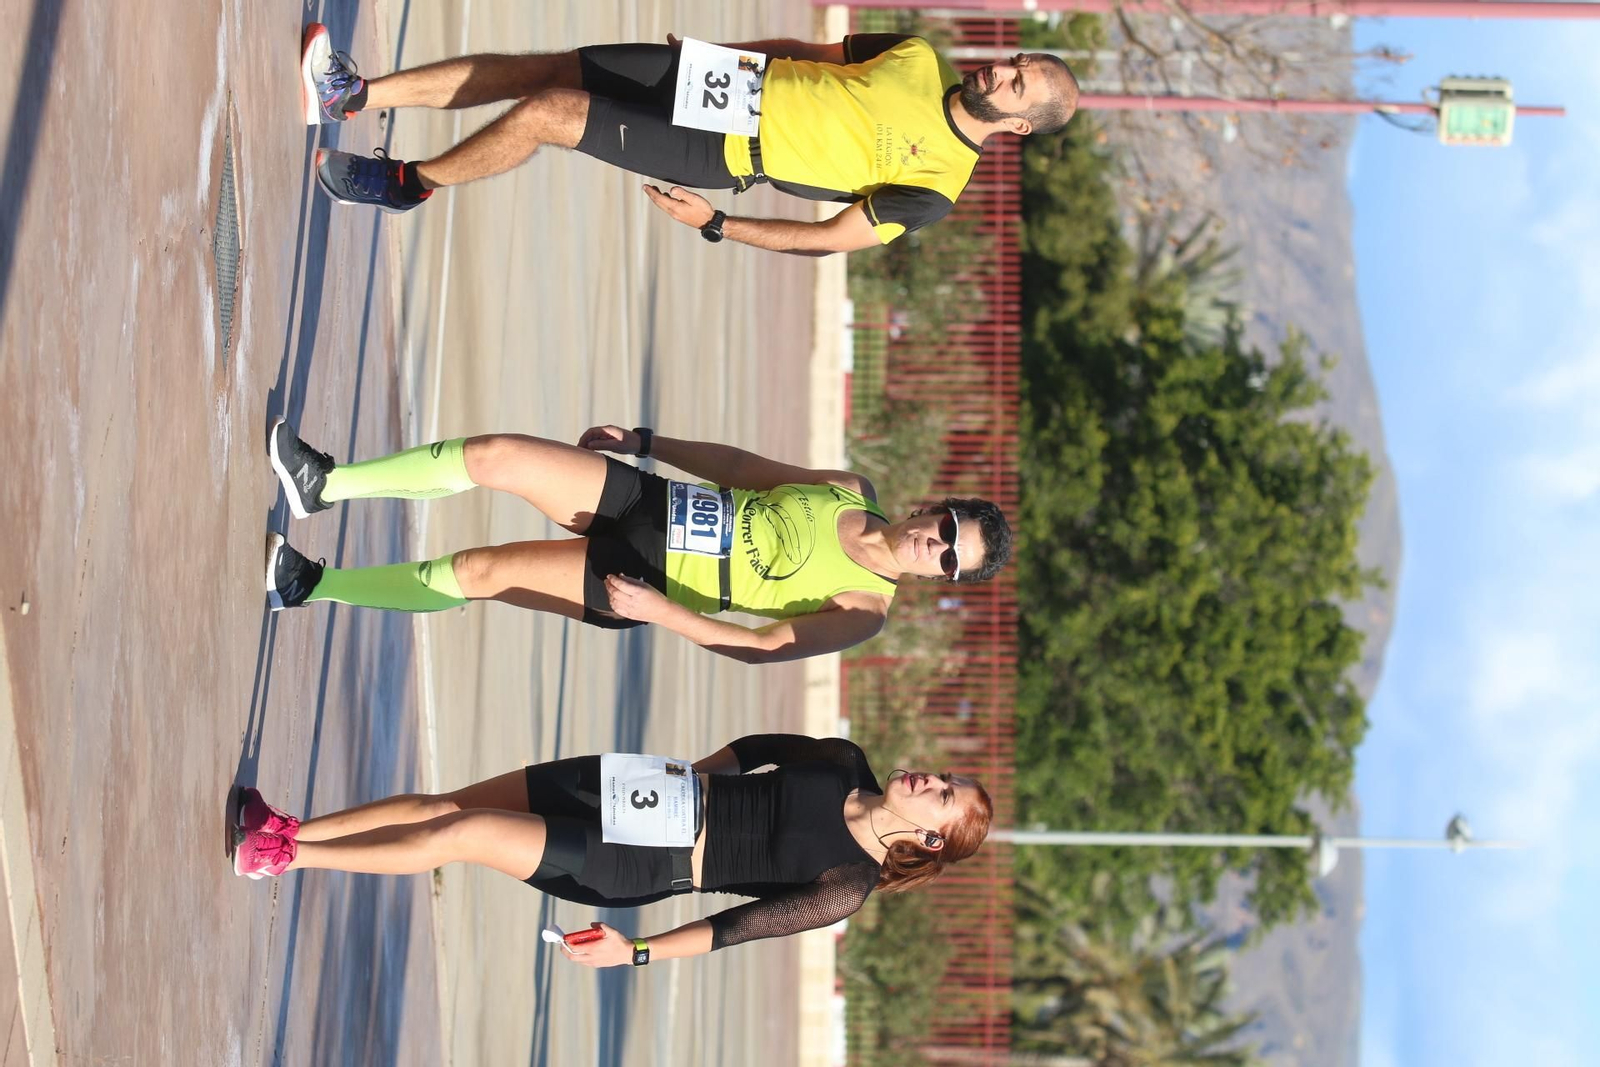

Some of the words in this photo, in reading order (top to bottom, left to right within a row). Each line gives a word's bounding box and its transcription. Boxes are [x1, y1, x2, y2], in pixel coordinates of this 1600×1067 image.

[702, 70, 731, 110] 32
[876, 138, 883, 152] KM
[886, 127, 893, 136] LA
[691, 492, 720, 538] 4981
[798, 497, 816, 522] Estilo
[741, 507, 757, 546] Correr
[745, 547, 771, 579] Fácil
[630, 789, 659, 810] 3
